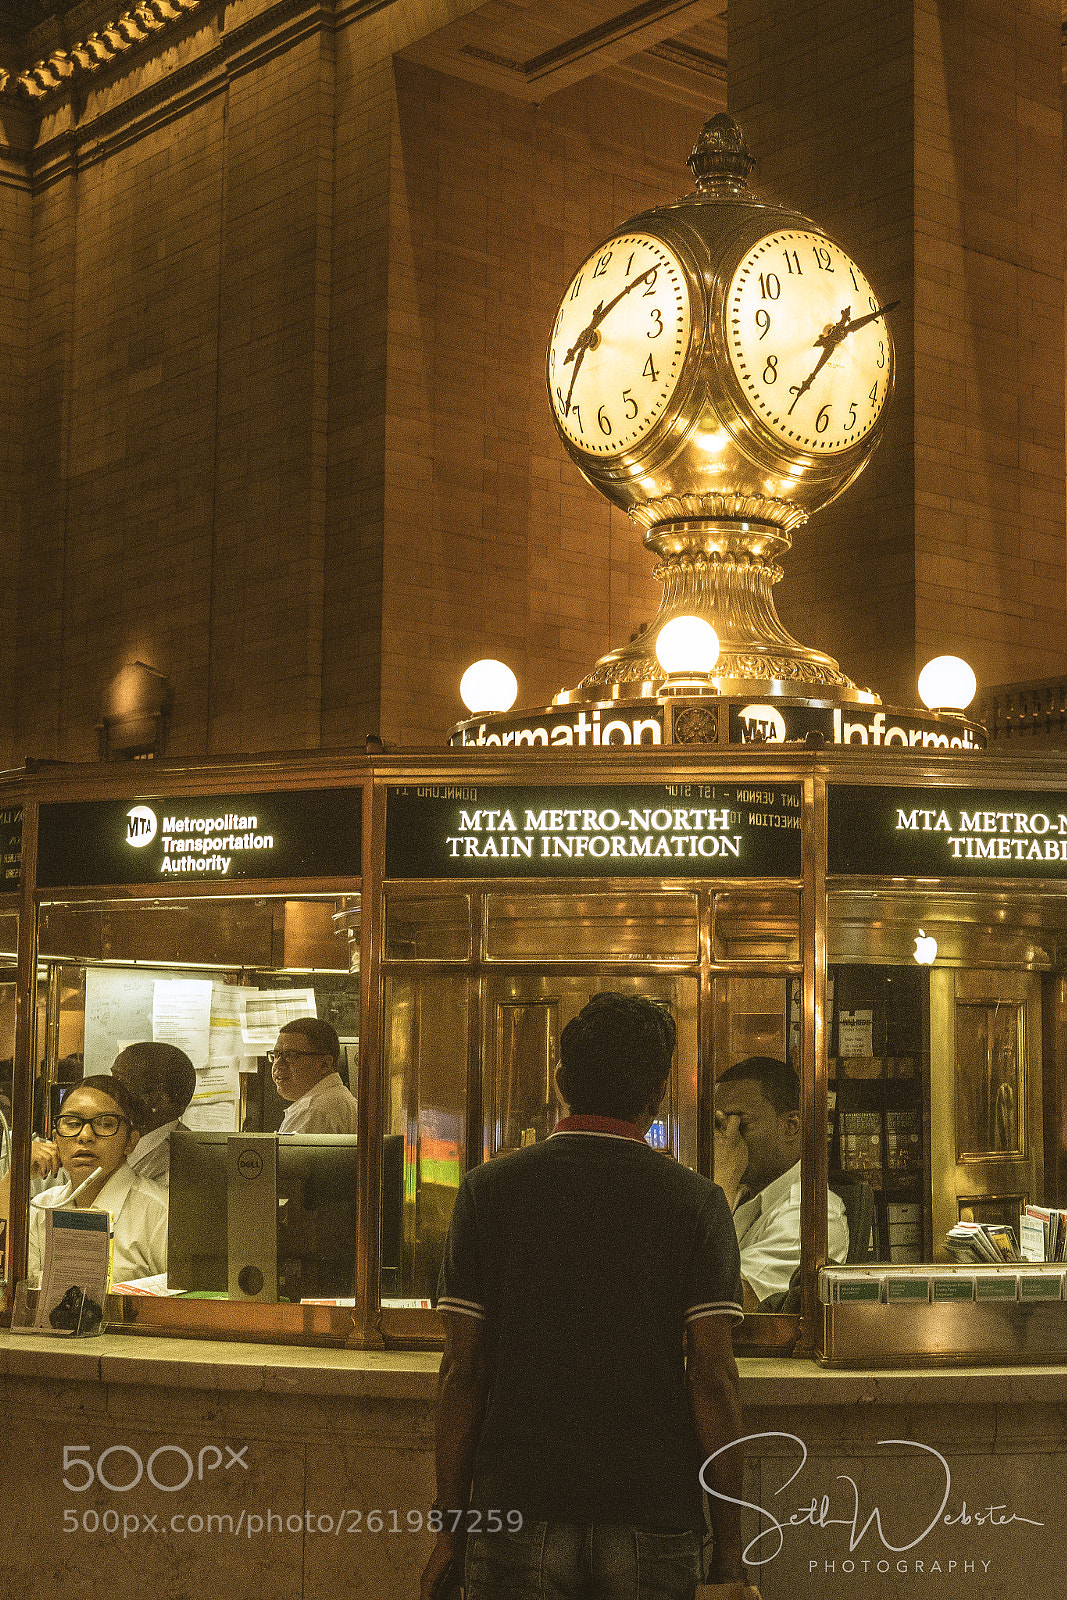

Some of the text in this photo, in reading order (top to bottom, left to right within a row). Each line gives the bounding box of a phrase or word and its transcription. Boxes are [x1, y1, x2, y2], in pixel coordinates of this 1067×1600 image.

[592, 251, 613, 279] 12
[625, 252, 635, 277] 1
[782, 249, 804, 275] 11
[812, 246, 835, 273] 12
[570, 273, 585, 302] 11
[642, 265, 658, 298] 2
[758, 272, 781, 301] 10
[849, 267, 860, 292] 1
[646, 308, 664, 339] 3
[755, 309, 771, 341] 9
[642, 353, 660, 383] 4
[876, 340, 885, 369] 3
[762, 354, 778, 385] 8
[556, 386, 566, 415] 8
[622, 388, 639, 420] 5
[788, 385, 801, 416] 7
[868, 380, 879, 408] 4
[572, 405, 584, 434] 7
[597, 404, 612, 436] 6
[815, 404, 833, 434] 6
[843, 402, 859, 431] 5
[462, 710, 662, 747] formation
[833, 708, 983, 750] Informti
[162, 813, 258, 834] Metropolitan
[458, 809, 730, 831] MTA METRO-NORTH
[895, 808, 953, 831] MTA
[161, 833, 274, 854] Transportation
[446, 836, 742, 858] TRAIN INFORMATION
[160, 854, 231, 874] Authority
